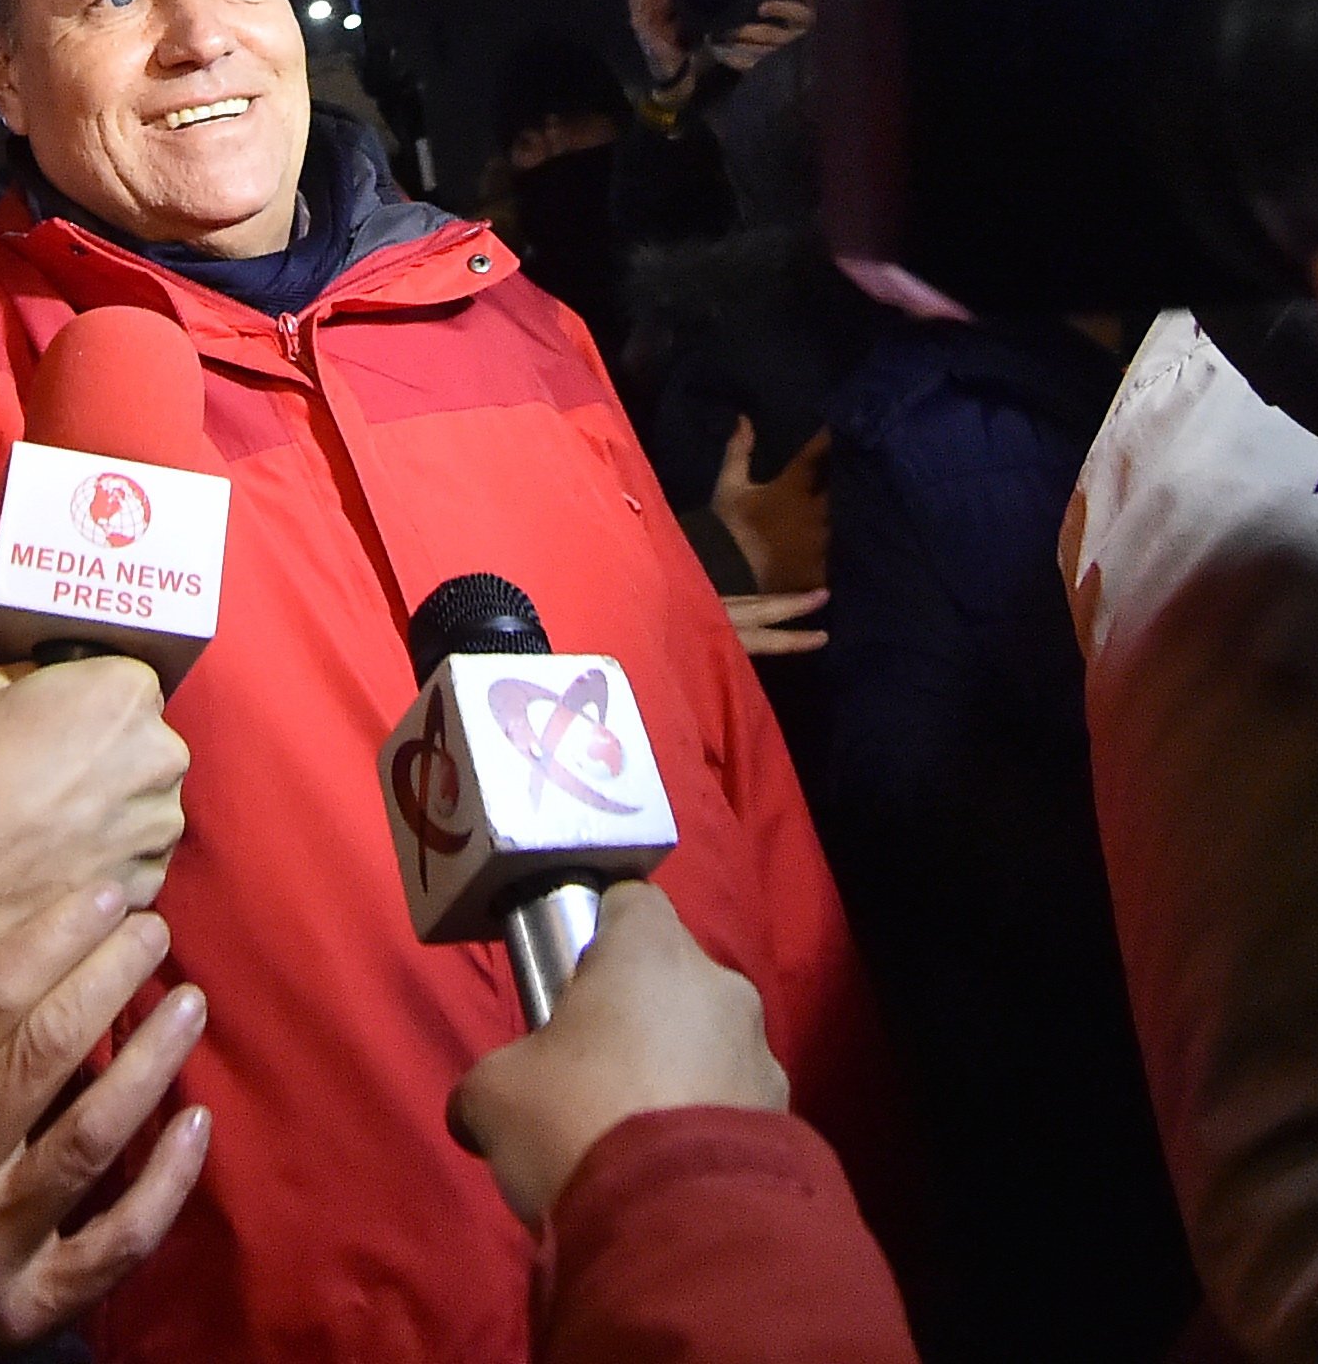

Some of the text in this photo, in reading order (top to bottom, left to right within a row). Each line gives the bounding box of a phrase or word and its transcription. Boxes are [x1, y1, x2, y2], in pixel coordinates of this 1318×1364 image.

[10, 543, 203, 597] MEDIA NEWS
[52, 581, 154, 619] PRESS
